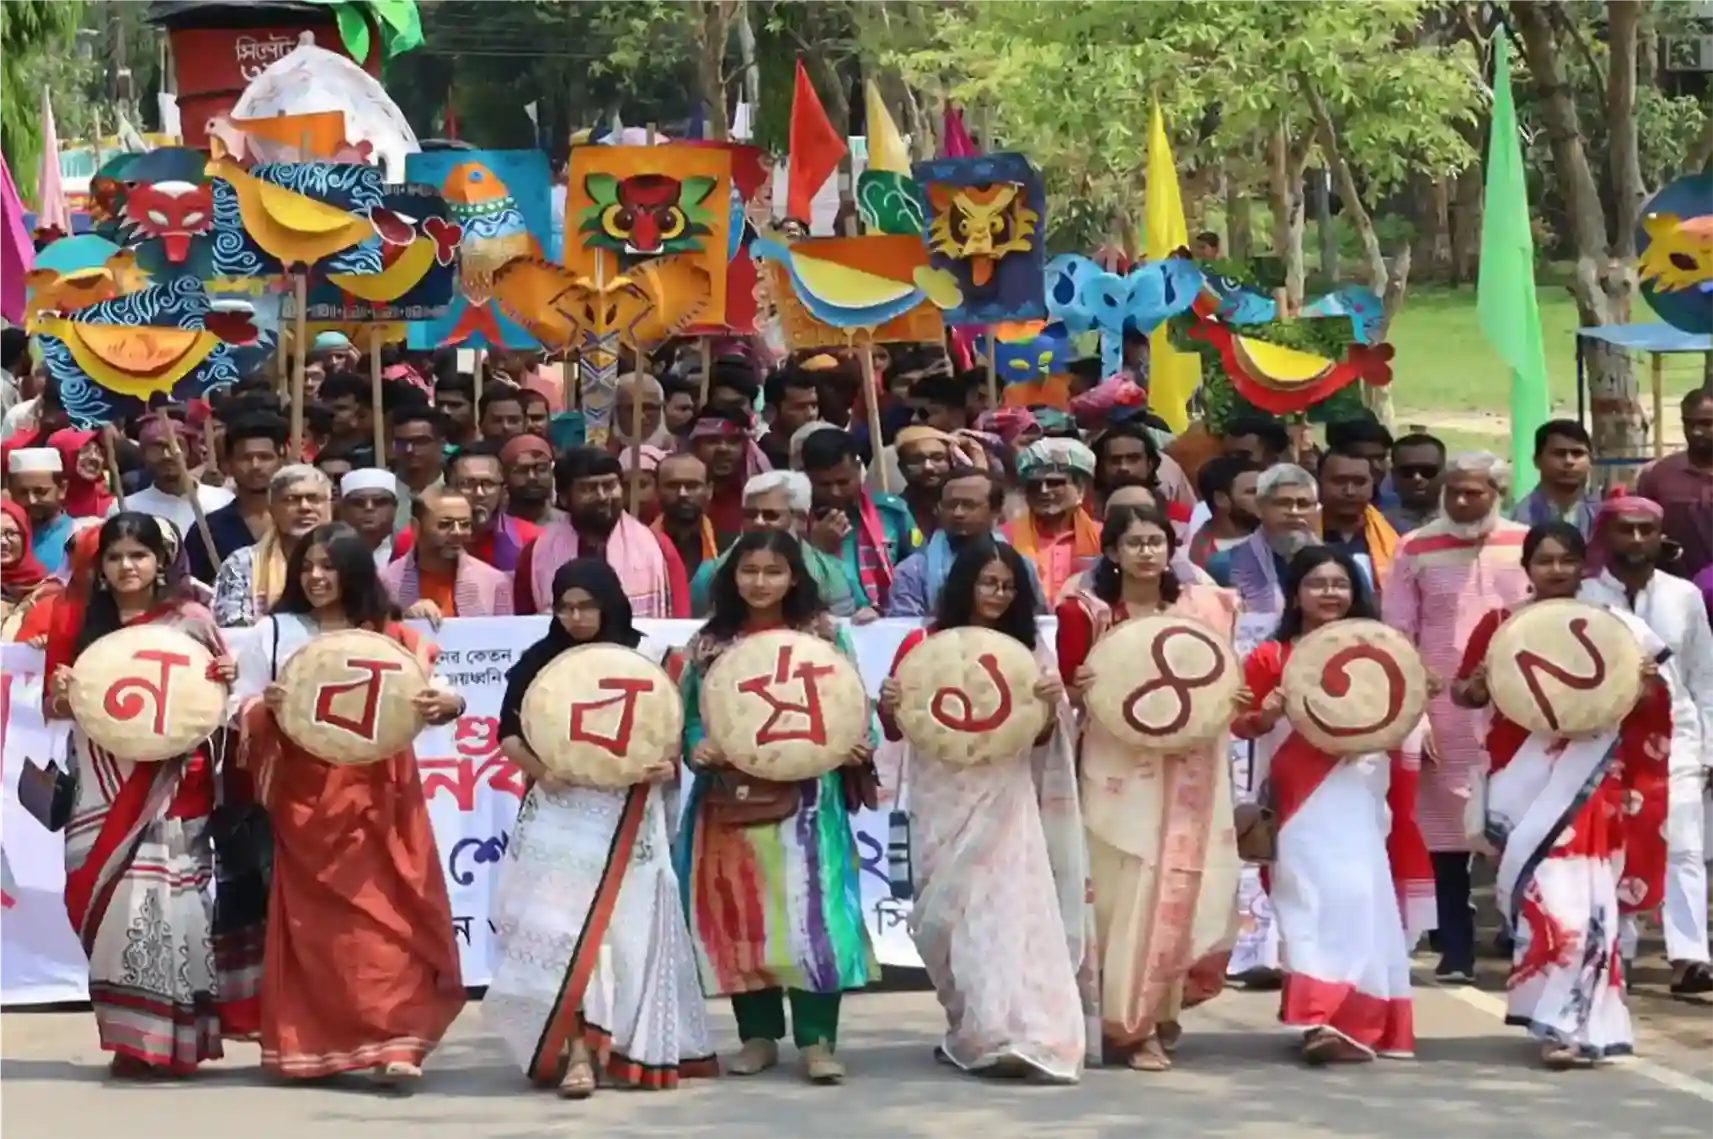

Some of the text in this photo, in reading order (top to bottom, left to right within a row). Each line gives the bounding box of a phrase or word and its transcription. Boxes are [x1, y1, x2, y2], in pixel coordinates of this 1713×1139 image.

[104, 650, 190, 735] ন
[466, 649, 512, 665] কেতন
[931, 653, 1012, 734] ১
[1122, 625, 1226, 737] ৪
[1302, 643, 1407, 738] ৩
[1515, 617, 1607, 732] ২
[315, 659, 403, 740] ব
[570, 678, 654, 756] ব
